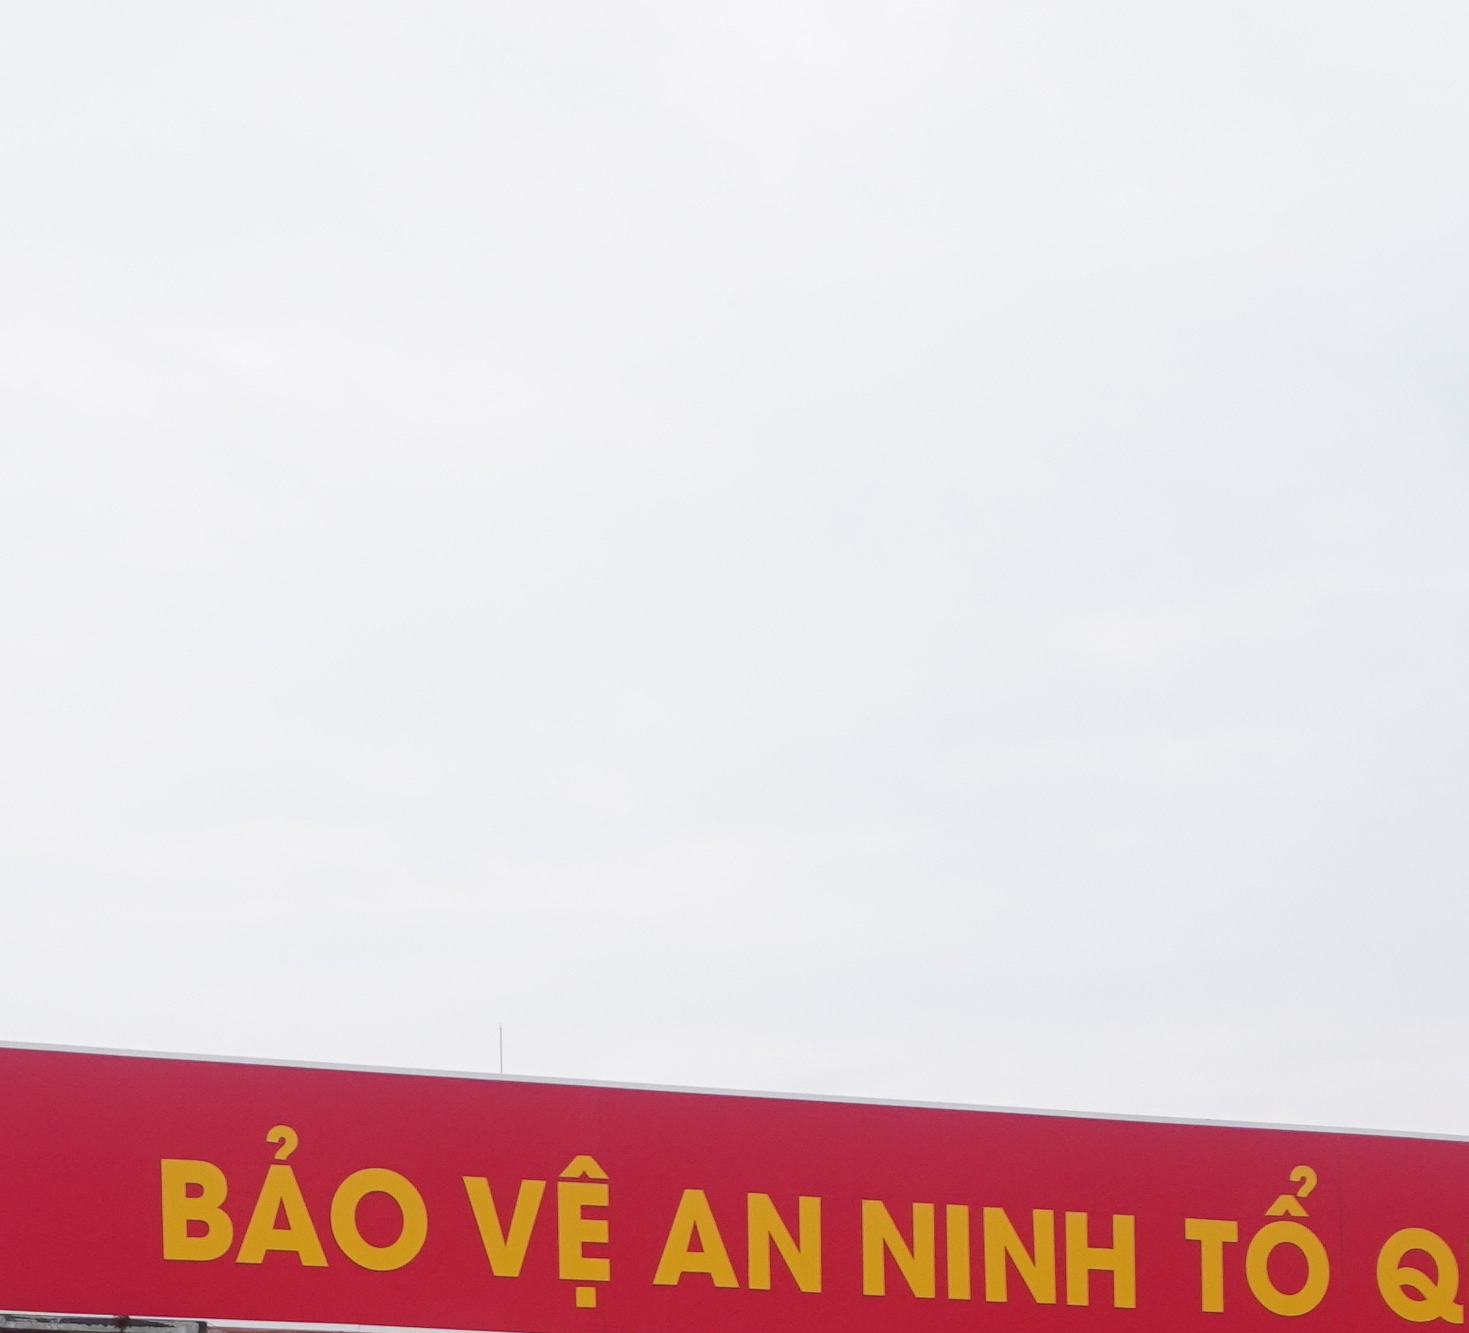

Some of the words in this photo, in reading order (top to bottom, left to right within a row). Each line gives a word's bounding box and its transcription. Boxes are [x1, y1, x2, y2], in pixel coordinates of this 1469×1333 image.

[161, 1125, 427, 1271] BẢO
[463, 1154, 610, 1308] VỆ
[653, 1189, 821, 1293] AN
[862, 1199, 1136, 1309] NINH
[1185, 1165, 1329, 1317] TỔ
